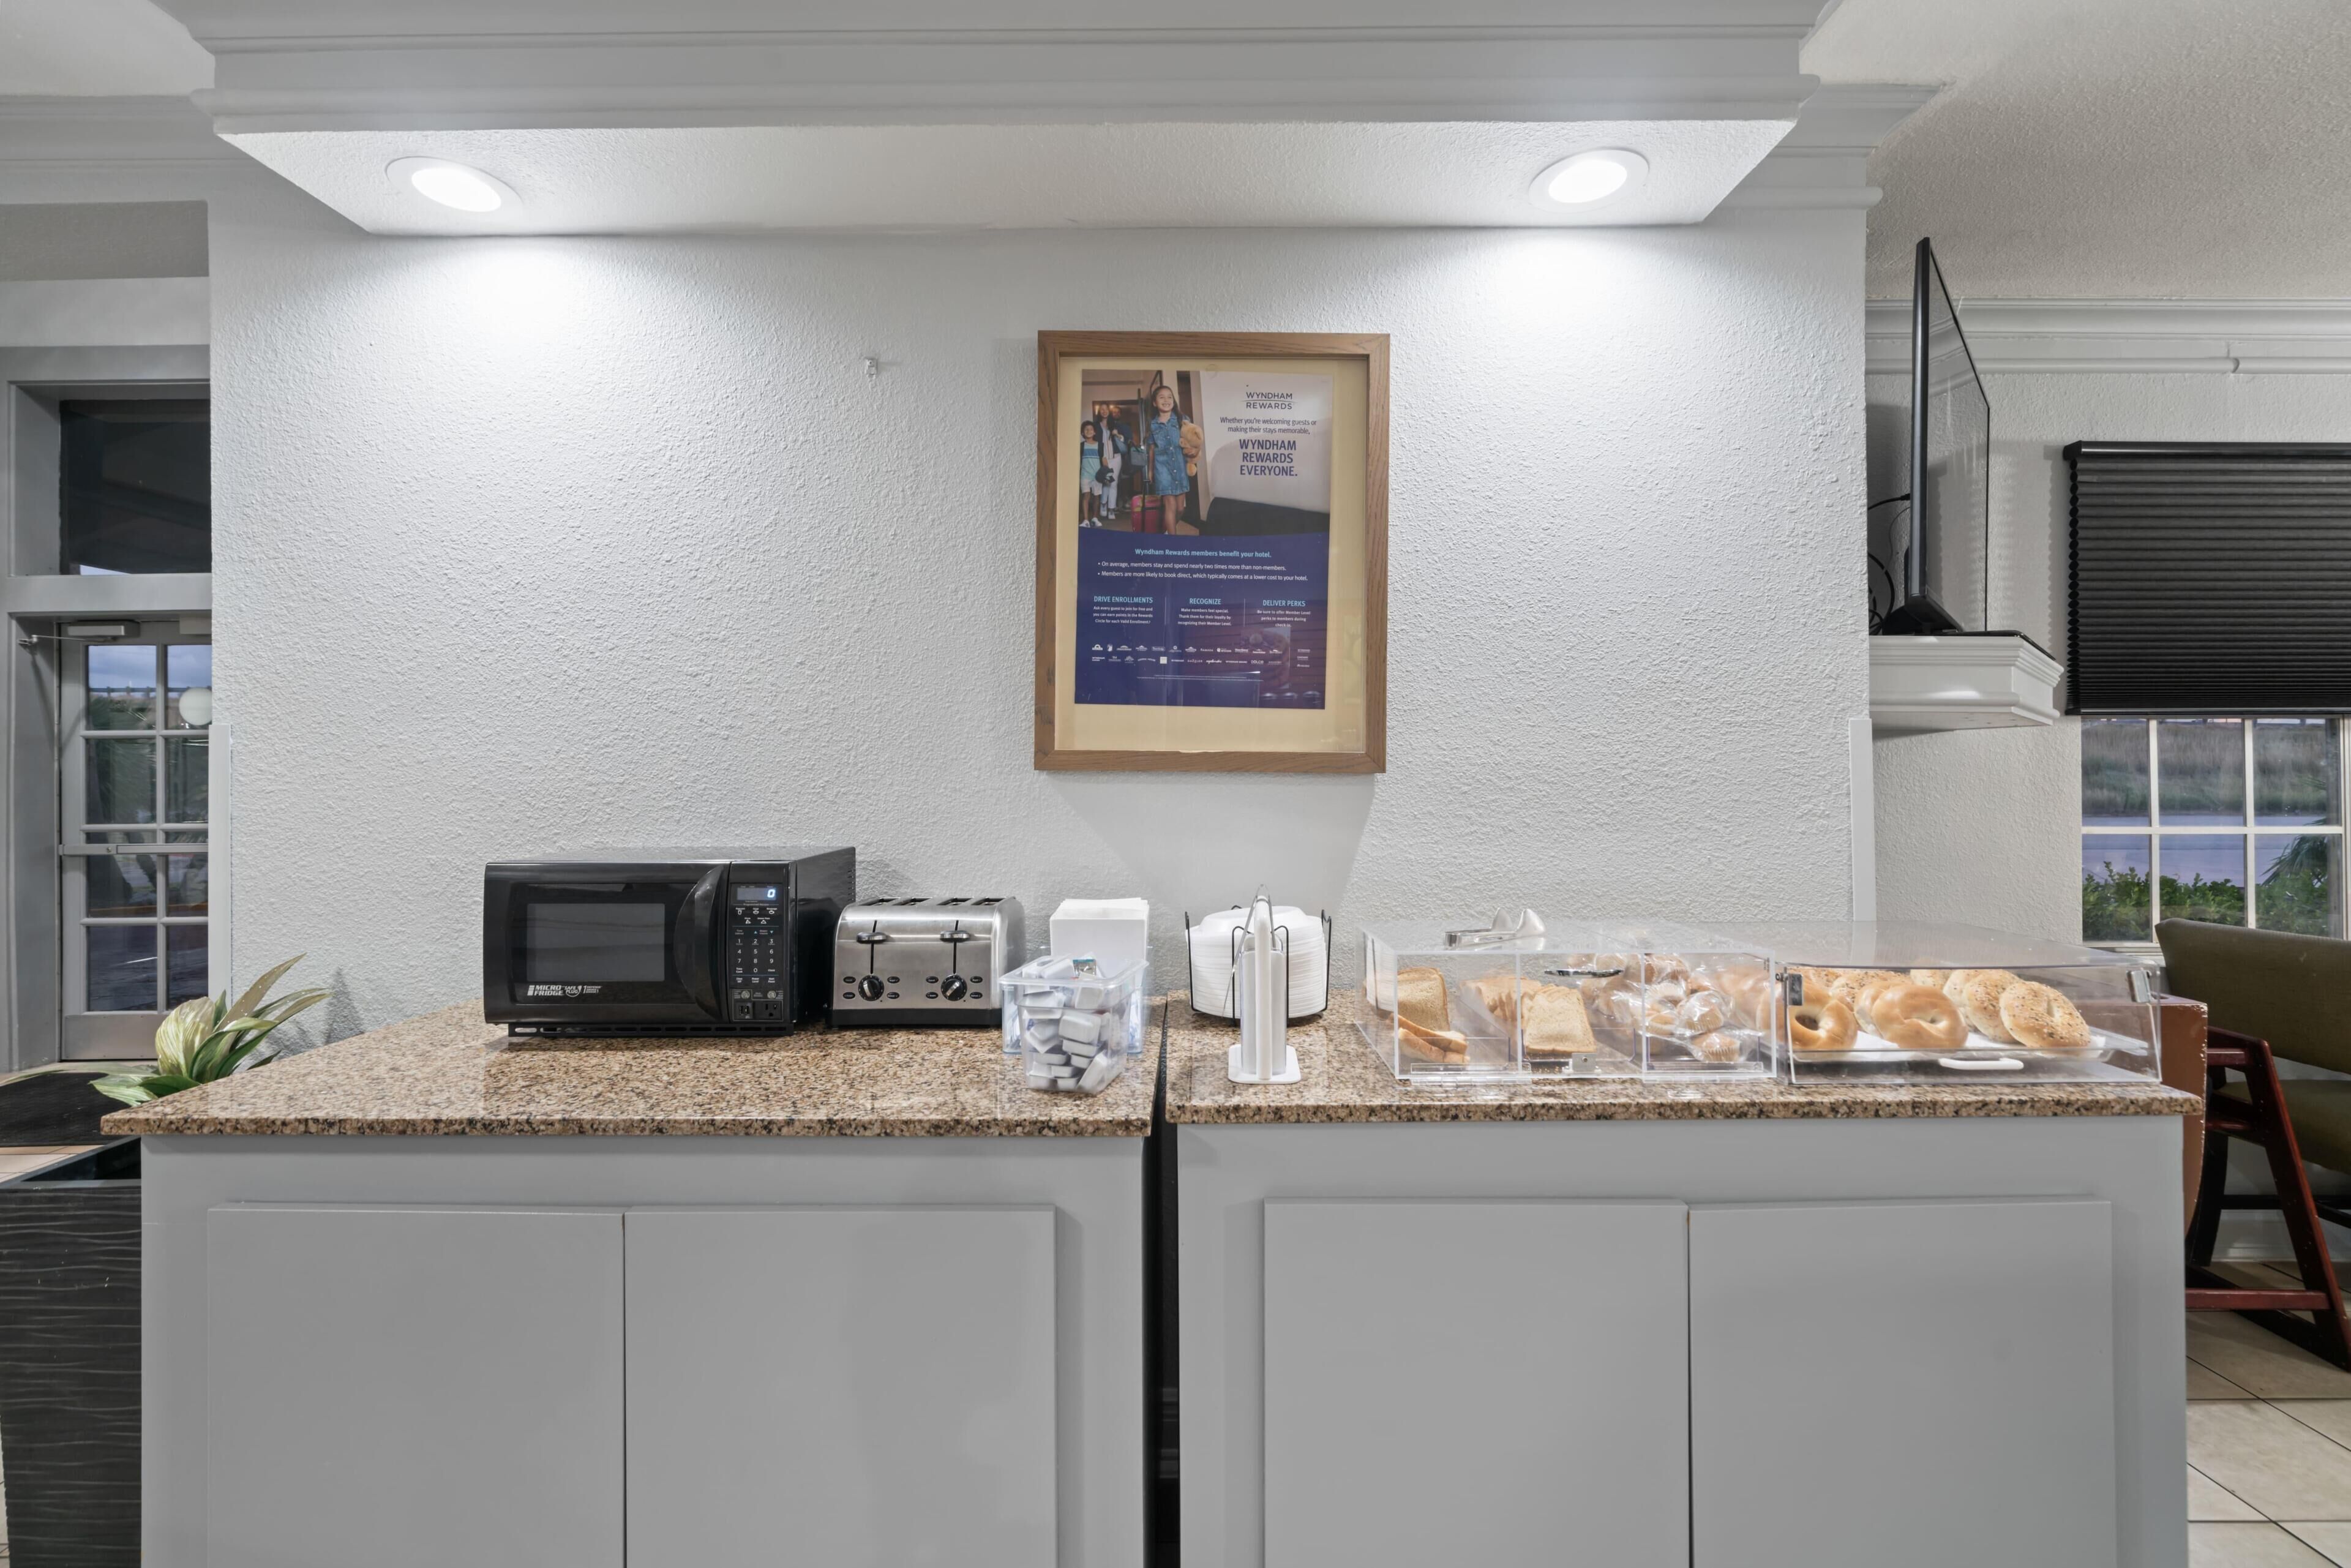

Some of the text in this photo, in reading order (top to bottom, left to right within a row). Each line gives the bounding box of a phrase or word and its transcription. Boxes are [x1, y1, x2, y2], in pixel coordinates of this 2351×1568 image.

[1262, 418, 1291, 426] welcoming
[1239, 439, 1297, 451] WYNDHAM
[1242, 452, 1294, 463] REWARDS
[1240, 465, 1298, 476] EVERYONE.
[767, 889, 776, 898] 0
